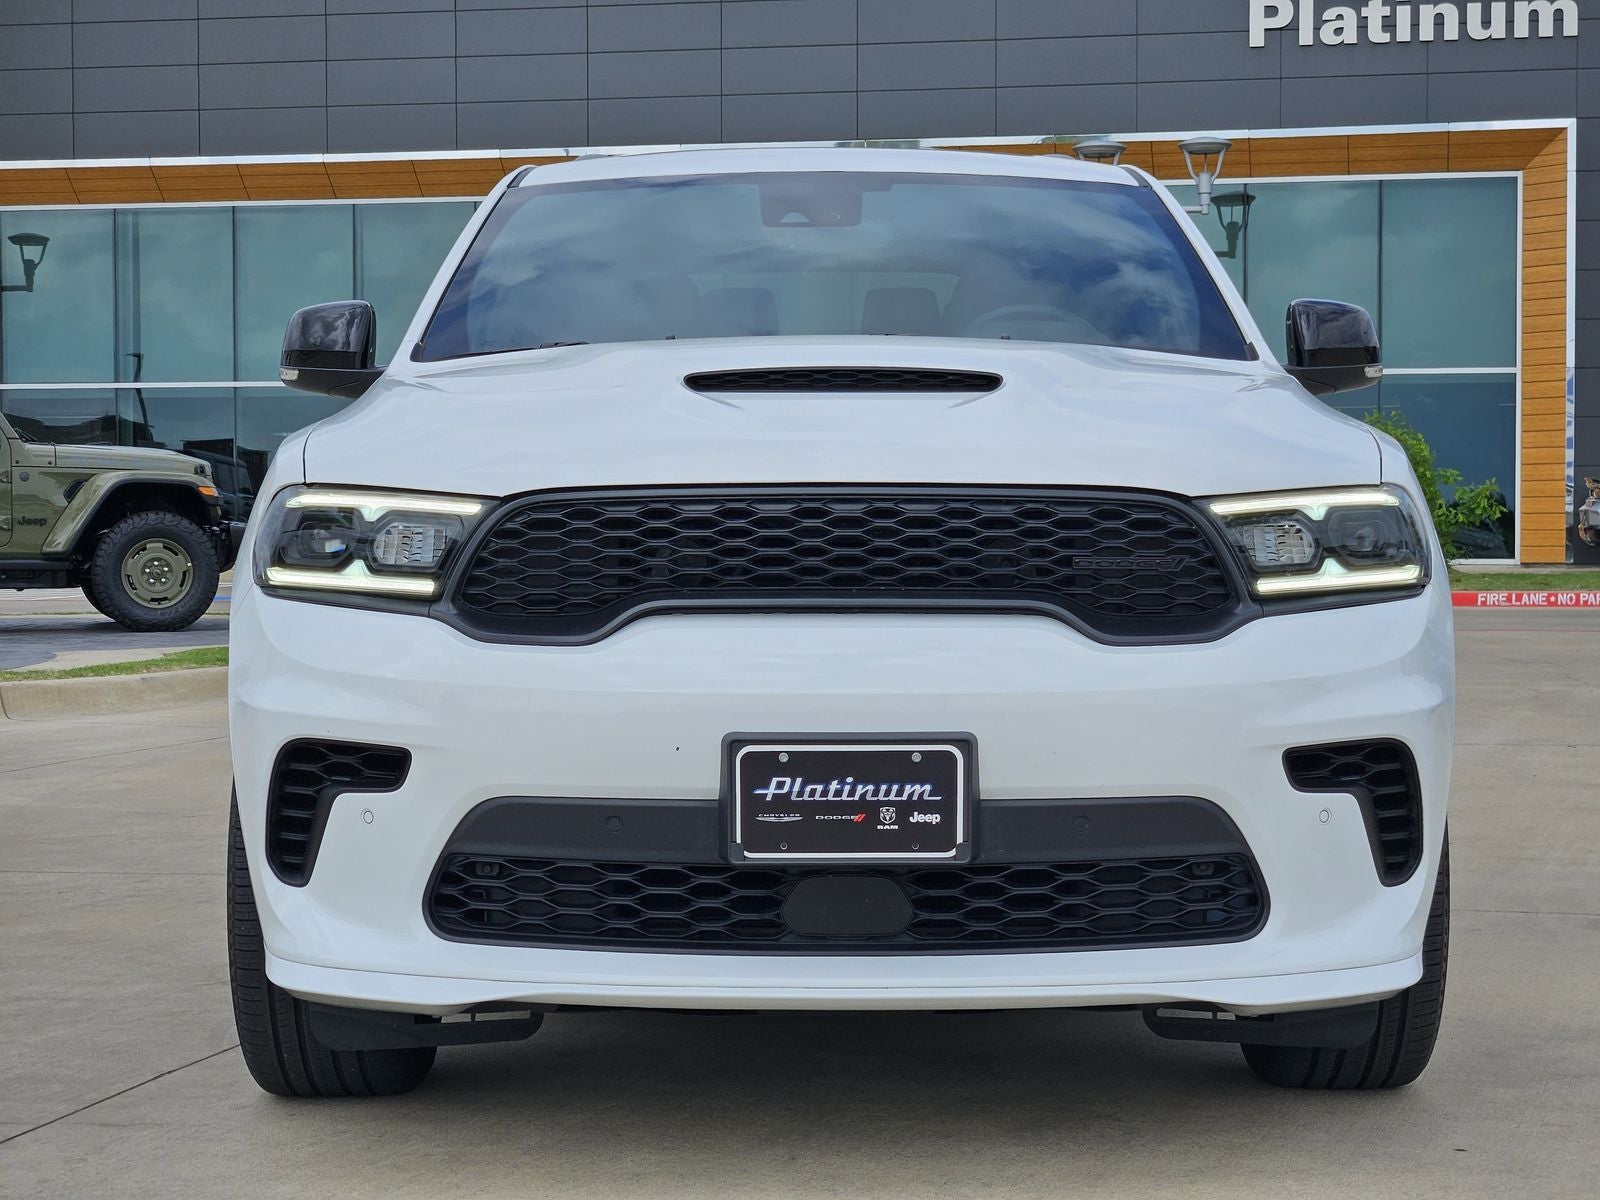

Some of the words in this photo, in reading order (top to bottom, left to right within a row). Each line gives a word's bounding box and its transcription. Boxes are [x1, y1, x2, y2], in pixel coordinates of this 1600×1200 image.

[1249, 0, 1579, 48] Platinum
[18, 516, 48, 527] Jeep
[1477, 593, 1508, 606] FIRE
[1511, 593, 1548, 606] LANE
[1557, 592, 1576, 606] NO
[753, 776, 942, 801] Platinum
[909, 811, 941, 825] Jeep
